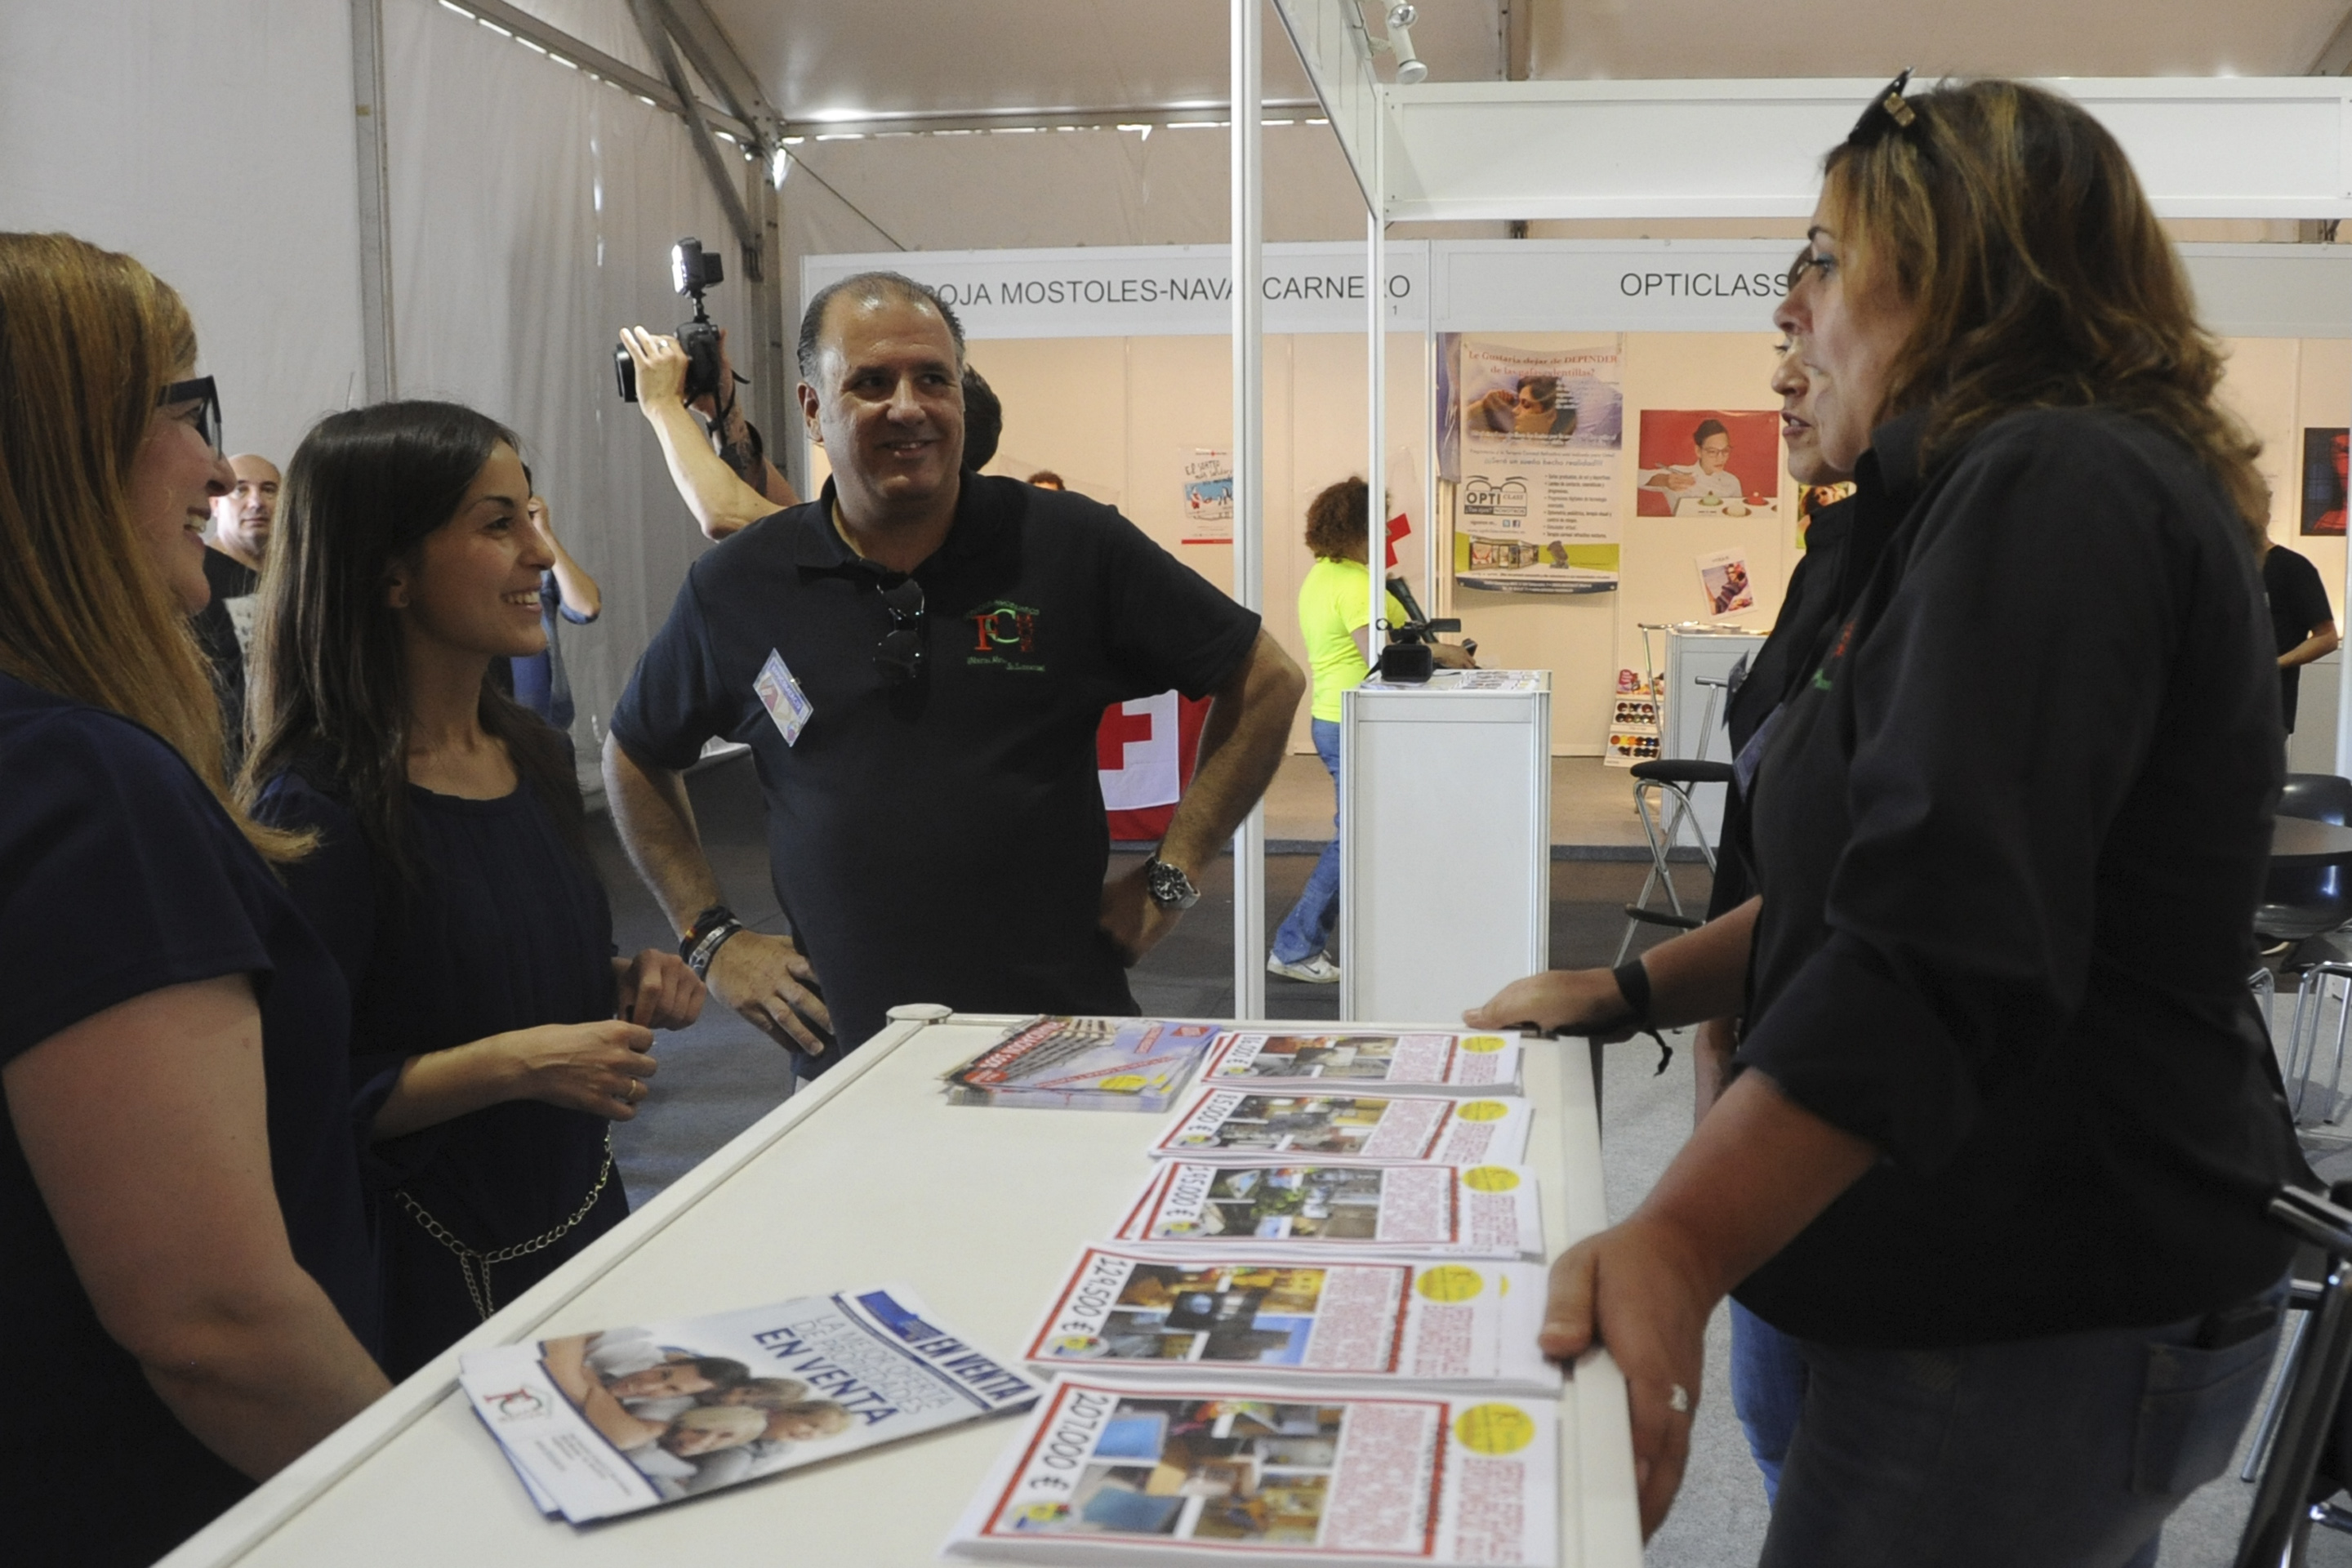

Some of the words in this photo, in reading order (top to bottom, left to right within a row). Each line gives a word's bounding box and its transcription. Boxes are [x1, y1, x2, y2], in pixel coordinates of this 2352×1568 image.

[1620, 272, 1789, 296] OPTICLASS
[1466, 492, 1501, 506] OPTI
[1072, 1257, 1127, 1317] 129.500
[1061, 1321, 1094, 1334] €
[751, 1327, 813, 1358] EN
[791, 1356, 900, 1427] VENTA
[1044, 1392, 1109, 1470] 207.000
[1029, 1477, 1070, 1490] €
